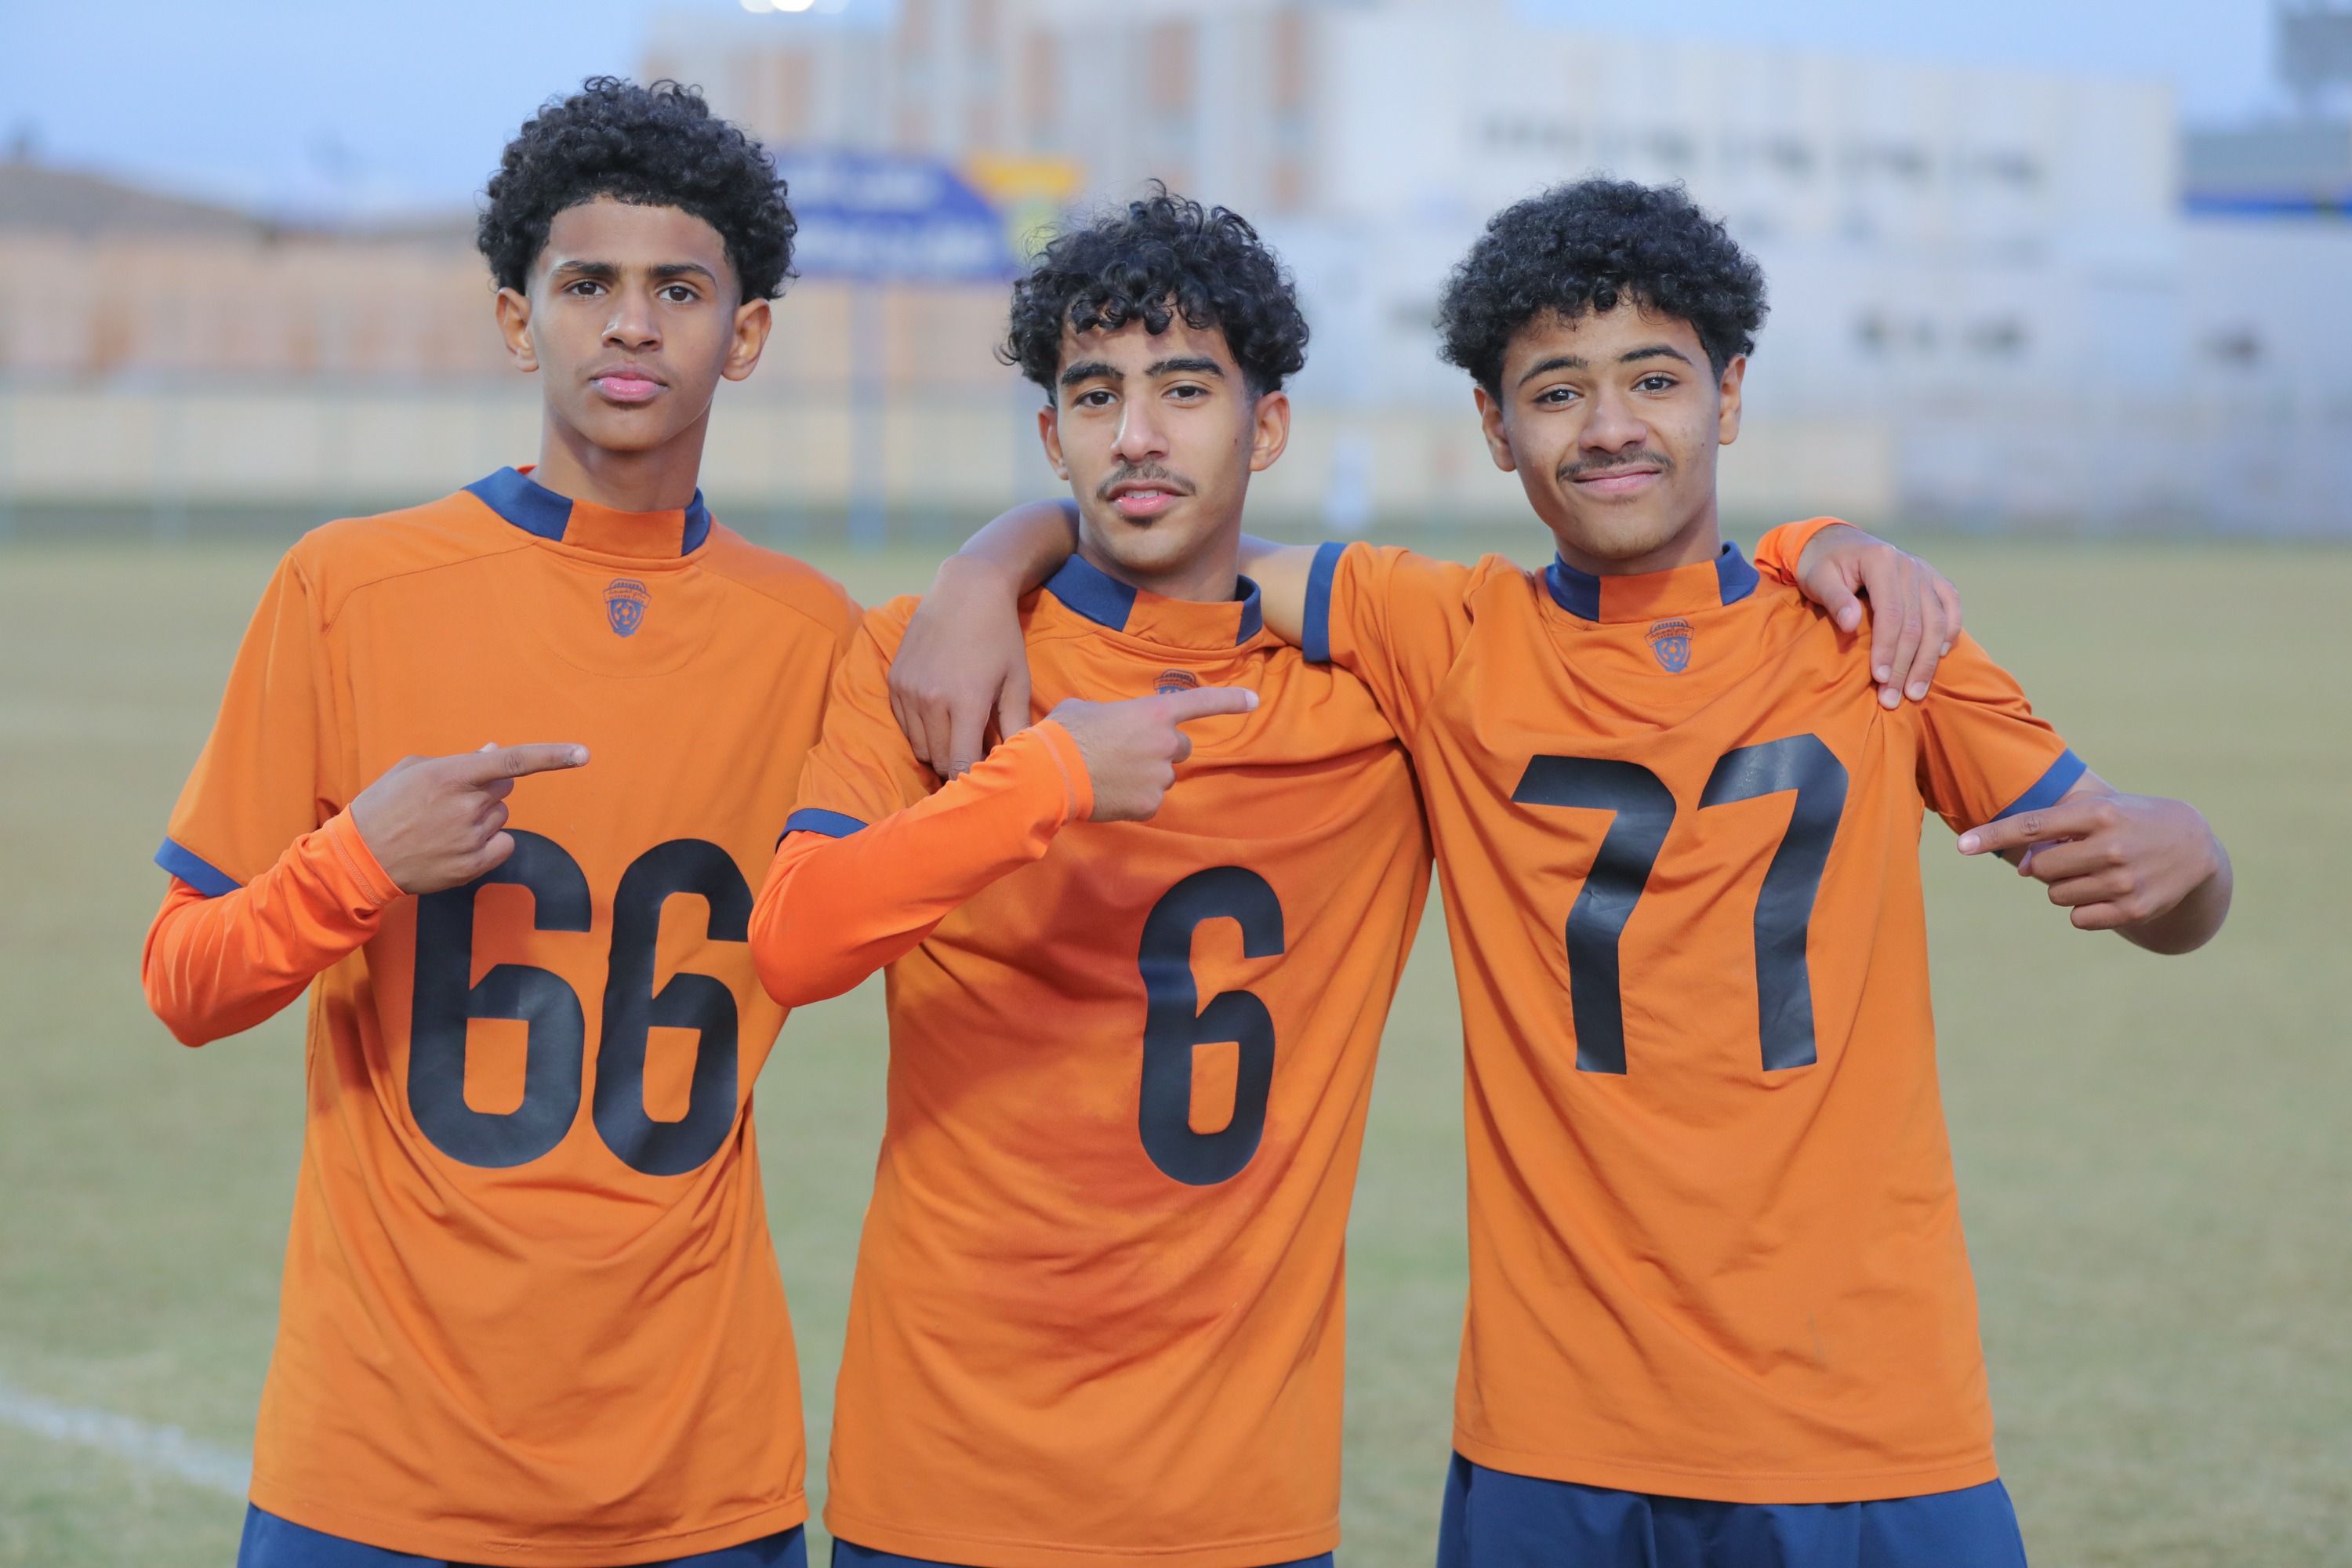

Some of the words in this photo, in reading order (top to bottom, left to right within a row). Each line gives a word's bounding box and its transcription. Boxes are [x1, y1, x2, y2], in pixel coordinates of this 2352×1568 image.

[407, 828, 754, 1177] 66
[1138, 866, 1284, 1186] 6
[1510, 733, 1849, 1075] 77
